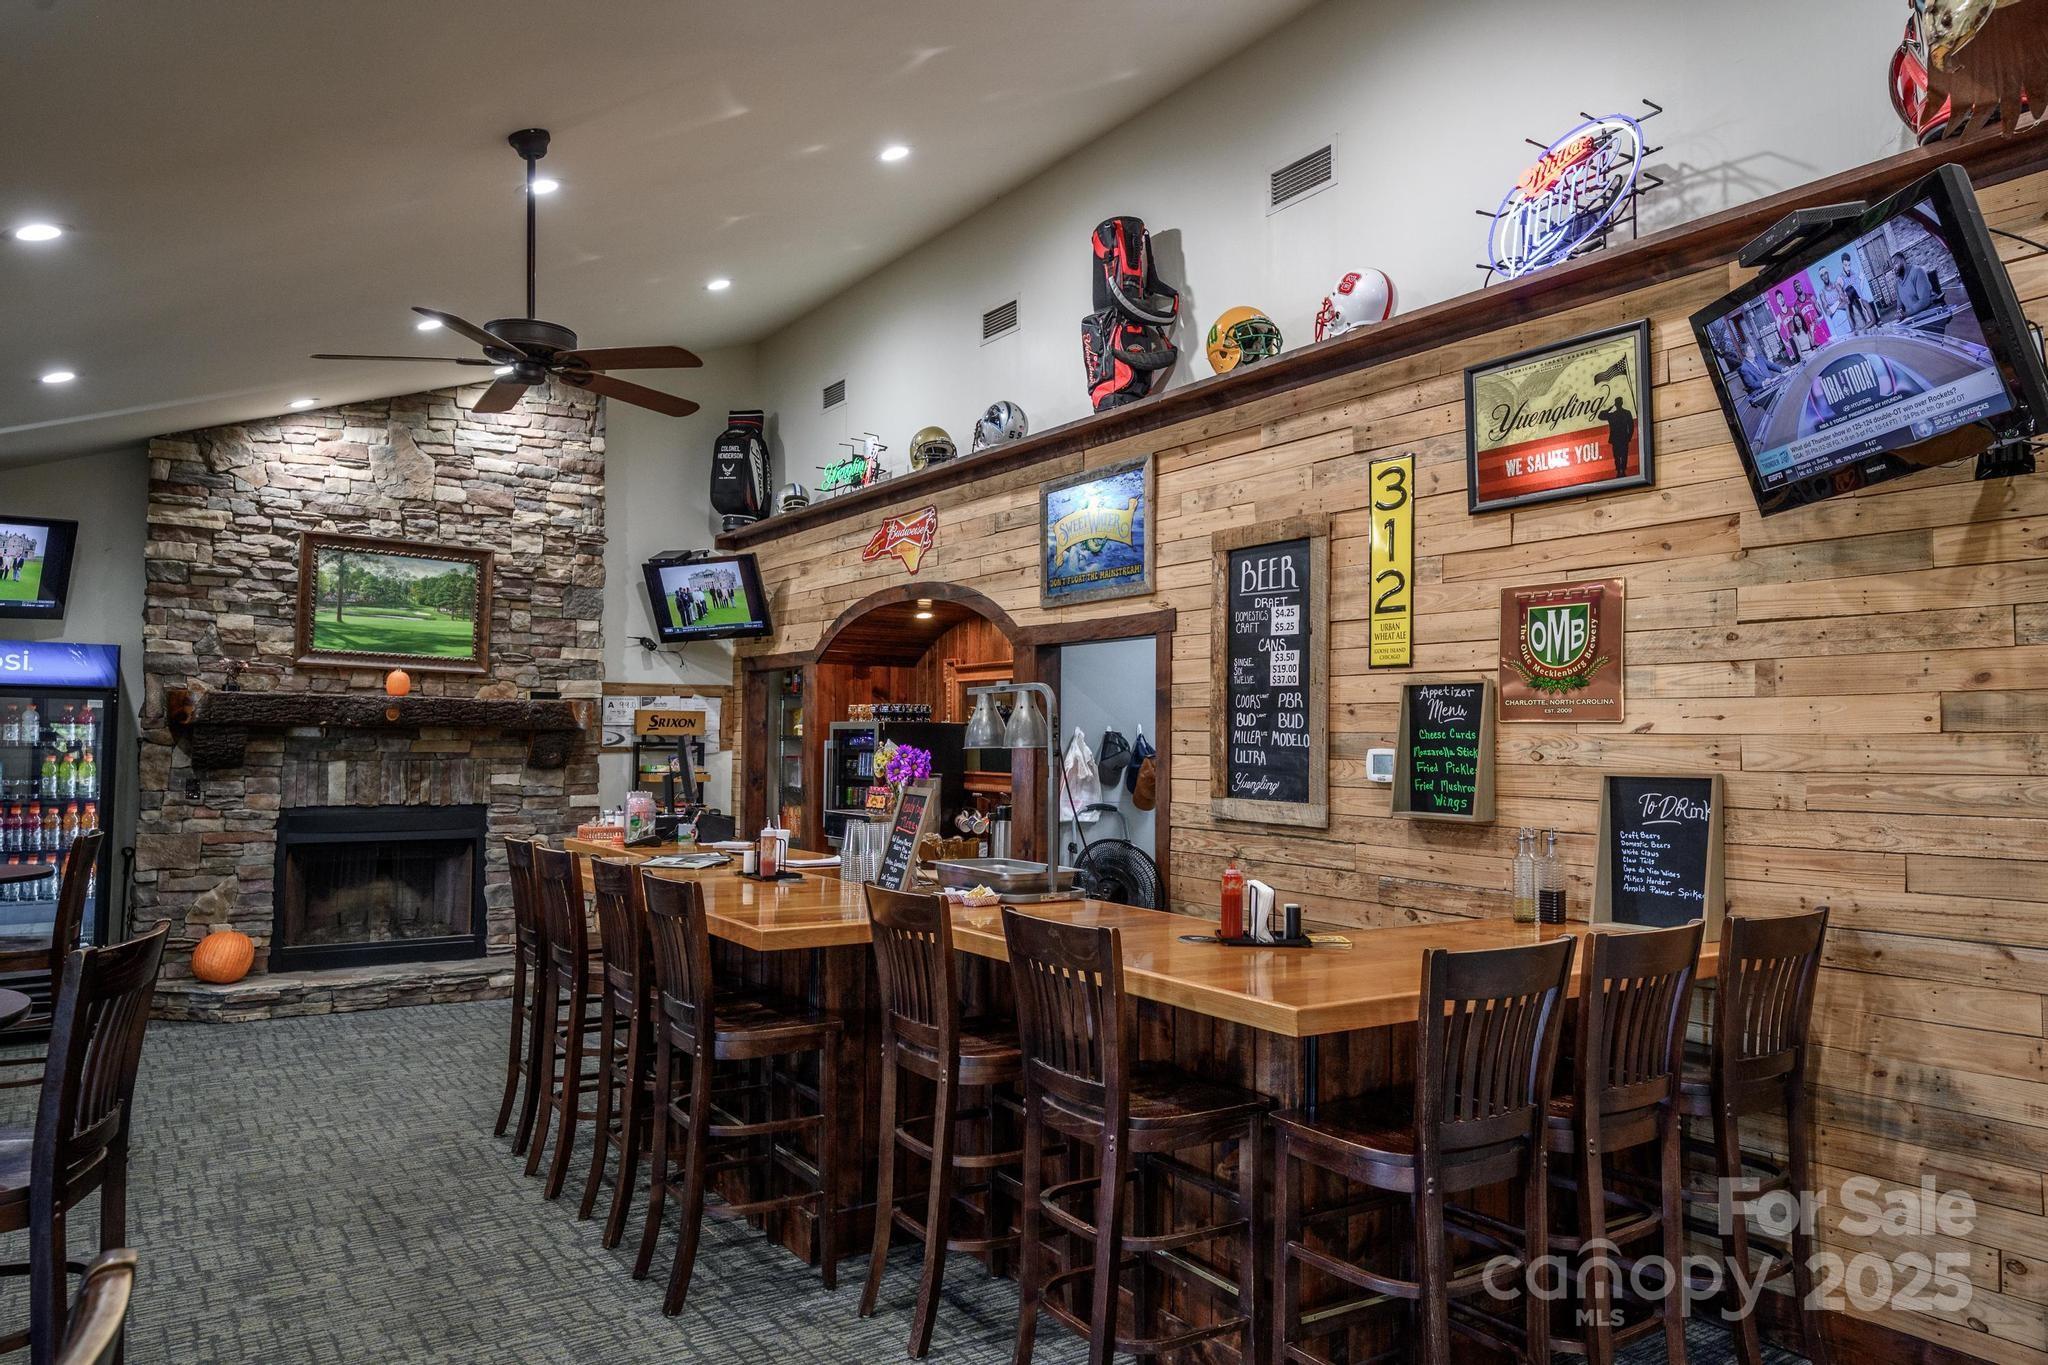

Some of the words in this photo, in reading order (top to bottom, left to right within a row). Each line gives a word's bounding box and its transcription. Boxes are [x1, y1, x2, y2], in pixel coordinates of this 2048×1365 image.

[1819, 373, 1845, 406] NBA
[1841, 360, 1878, 396] TODAY
[1902, 404, 1914, 412] win
[1914, 399, 1927, 408] over
[1927, 387, 1958, 403] Rockets?
[1488, 384, 1610, 442] Yuengling
[718, 452, 744, 460] HENDERSON
[1505, 458, 1523, 477] WE
[1527, 448, 1570, 472] SALUTE
[1574, 442, 1603, 462] YOU.
[1067, 574, 1086, 584] FLOAT
[1087, 572, 1098, 580] THE
[1240, 555, 1300, 593] BEER
[1254, 596, 1288, 608] DRAFT
[1235, 610, 1269, 622] DOMESTICS
[1275, 608, 1295, 618] $4.25
[1235, 622, 1260, 634] CRAFT
[1274, 622, 1295, 632] $5.25
[1380, 622, 1400, 631] URBAN
[1374, 632, 1394, 640] WHEAT
[1396, 631, 1406, 640] ALE
[1530, 608, 1585, 663] OMB
[1258, 638, 1287, 652] CANS
[1520, 644, 1532, 665] Olde
[1532, 660, 1588, 678] Mecklenburg
[1584, 618, 1598, 659] Brewery
[1274, 652, 1295, 663] $3.50
[1272, 664, 1297, 674] $19.00
[1272, 675, 1297, 685] $37.00
[1278, 692, 1303, 708] PBR
[1420, 686, 1475, 700] Appetizer
[1236, 694, 1260, 710] COORS
[1428, 698, 1468, 724] Menu
[648, 714, 697, 730] SRIXON
[1236, 712, 1256, 727] BUD
[1278, 712, 1304, 729] BUD
[1233, 730, 1261, 746] MILLER
[1271, 730, 1310, 748] MODELO
[1419, 729, 1447, 740] Cheese
[1450, 728, 1477, 740] Curds
[1235, 748, 1267, 766] ULTRA
[1414, 746, 1455, 758] Mozzarella
[1416, 762, 1439, 773] Fried
[1232, 772, 1280, 796] Yuengling
[1414, 778, 1434, 791] Fried
[1440, 780, 1477, 793] Mushroo
[1434, 794, 1468, 811] Wings
[1638, 793, 1662, 818] To
[1620, 831, 1639, 839] Craft
[1640, 832, 1660, 840] Beers
[1621, 840, 1648, 848] Domestic
[1624, 875, 1644, 883] Mikes
[1623, 883, 1645, 892] Arnold
[1649, 886, 1675, 896] Palmer
